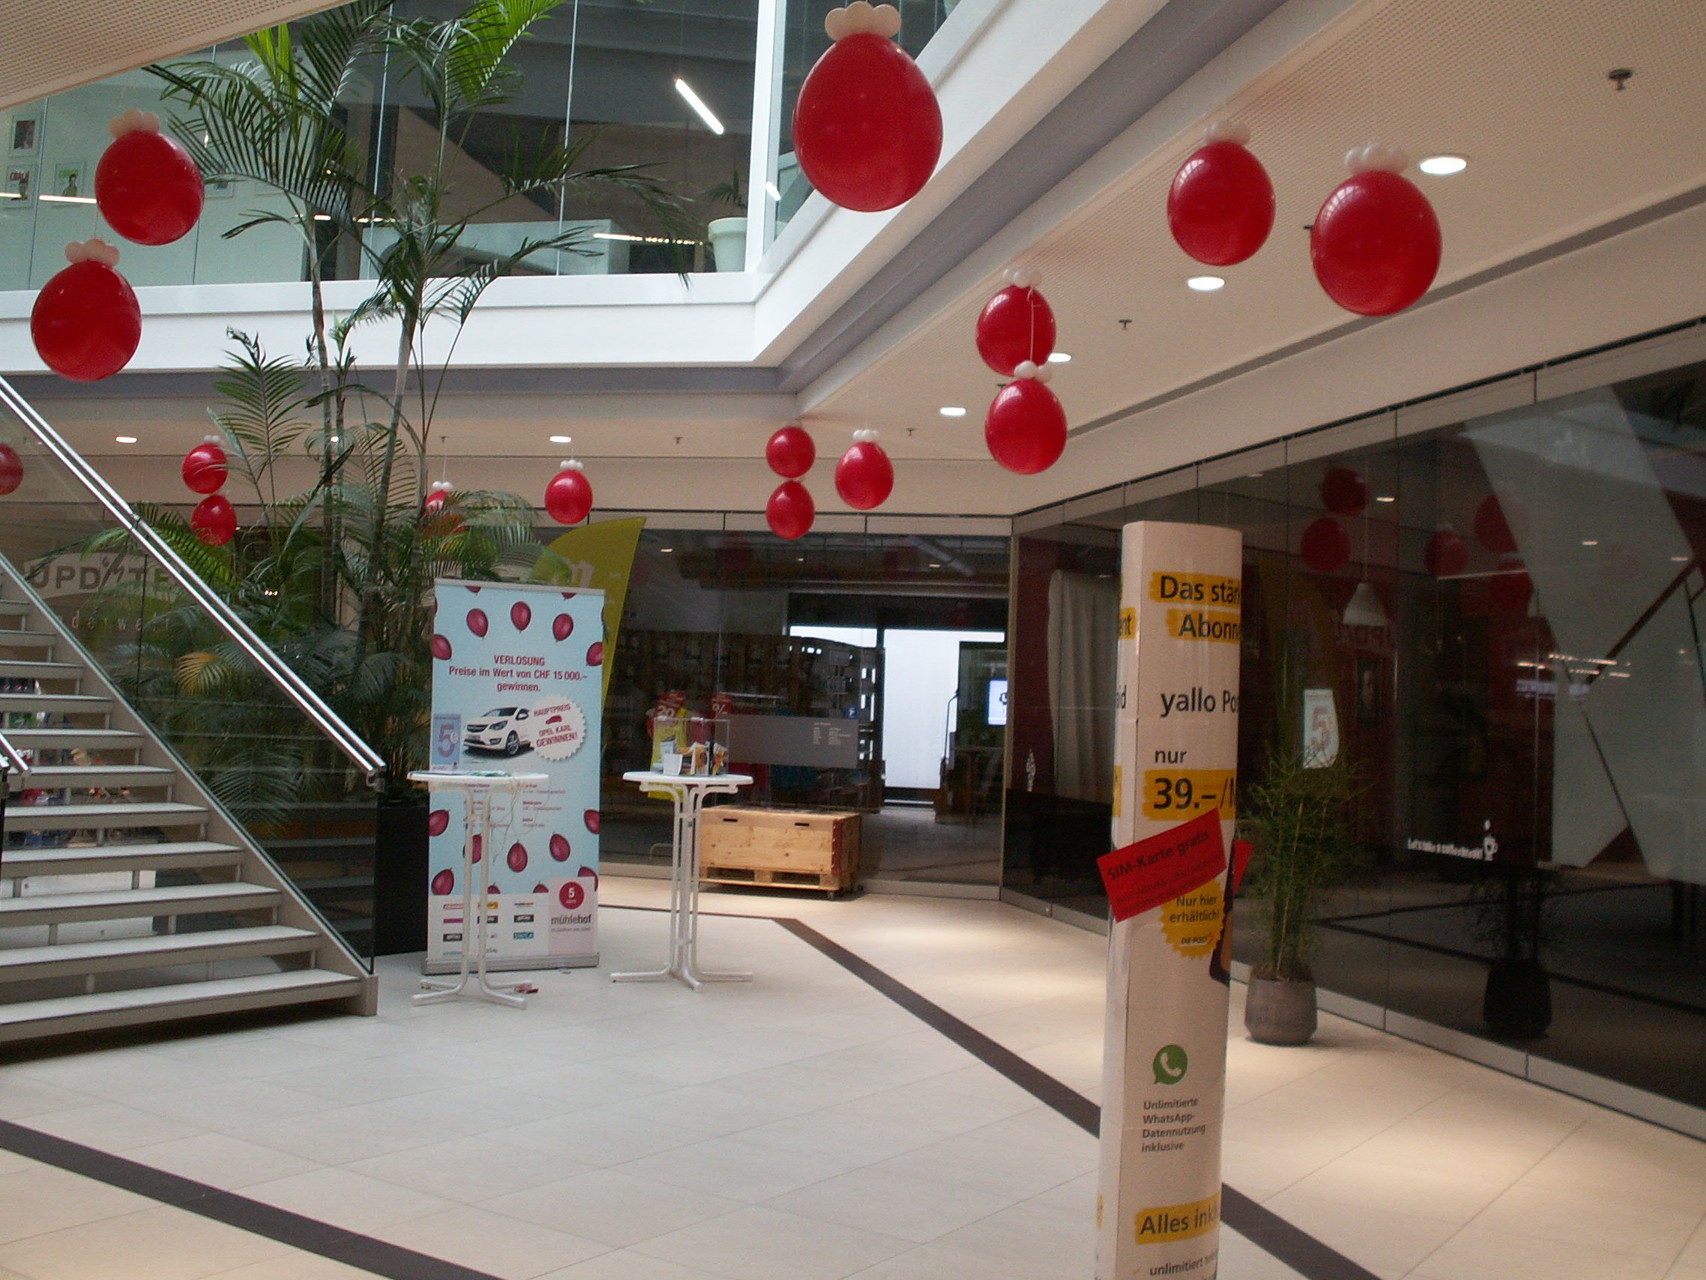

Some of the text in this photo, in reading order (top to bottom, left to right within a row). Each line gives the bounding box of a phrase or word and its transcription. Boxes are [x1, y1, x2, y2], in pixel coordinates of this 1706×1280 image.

[1159, 575, 1240, 604] Das stär
[1178, 613, 1240, 640] Abonn
[493, 654, 546, 666] VERLOSUNG
[448, 666, 477, 676] Preise
[479, 667, 491, 677] im
[493, 668, 513, 678] Wert
[516, 670, 531, 679] von
[533, 669, 551, 680] CHF
[496, 682, 541, 693] gewinnen.
[532, 703, 571, 717] HAUPTPREIS
[1160, 688, 1216, 718] yallo
[536, 732, 578, 748] GEWINNEN!
[1154, 747, 1187, 764] nur
[1107, 846, 1174, 881] SIM-Karte
[1177, 830, 1210, 857] gratis
[1176, 893, 1218, 906] Nur hier
[551, 913, 592, 926] mühlehof
[1169, 908, 1220, 924] erhältlich!
[1143, 1097, 1199, 1110] Unlimitierte
[1143, 1112, 1196, 1126] WhatsApp-
[1142, 1124, 1206, 1139] Datennutzung
[1141, 1141, 1185, 1153] inklusive
[1140, 1212, 1190, 1236] Alles
[1149, 1256, 1204, 1277] unlimitiert
